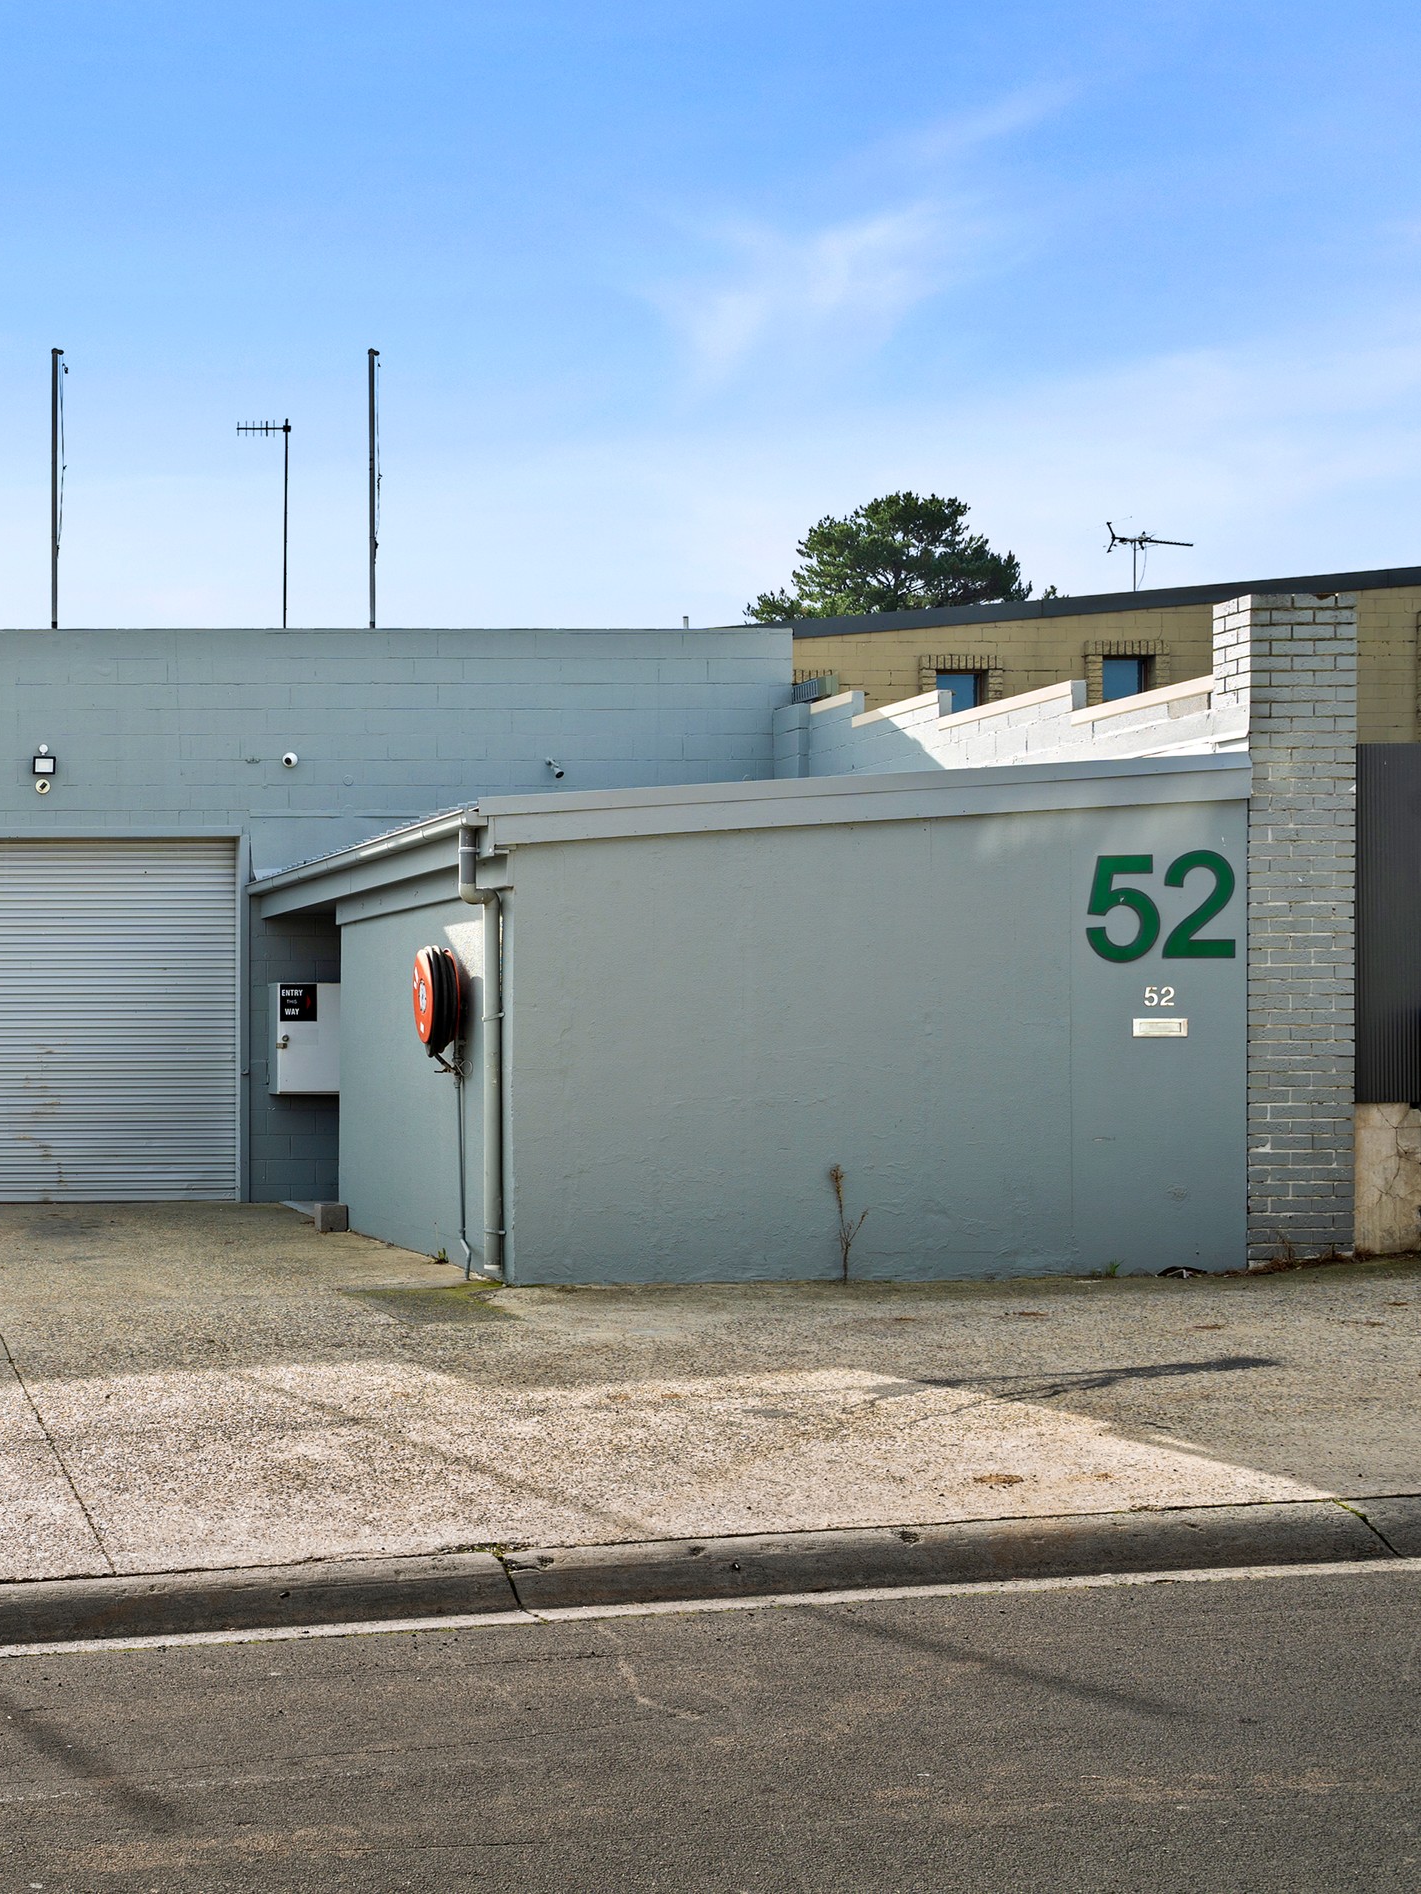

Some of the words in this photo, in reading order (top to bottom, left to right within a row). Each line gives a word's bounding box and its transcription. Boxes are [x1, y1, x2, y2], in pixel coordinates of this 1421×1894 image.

[1085, 849, 1236, 964] 52
[281, 989, 304, 997] ENTRY
[1143, 986, 1175, 1007] 52
[284, 1008, 300, 1016] WAY
